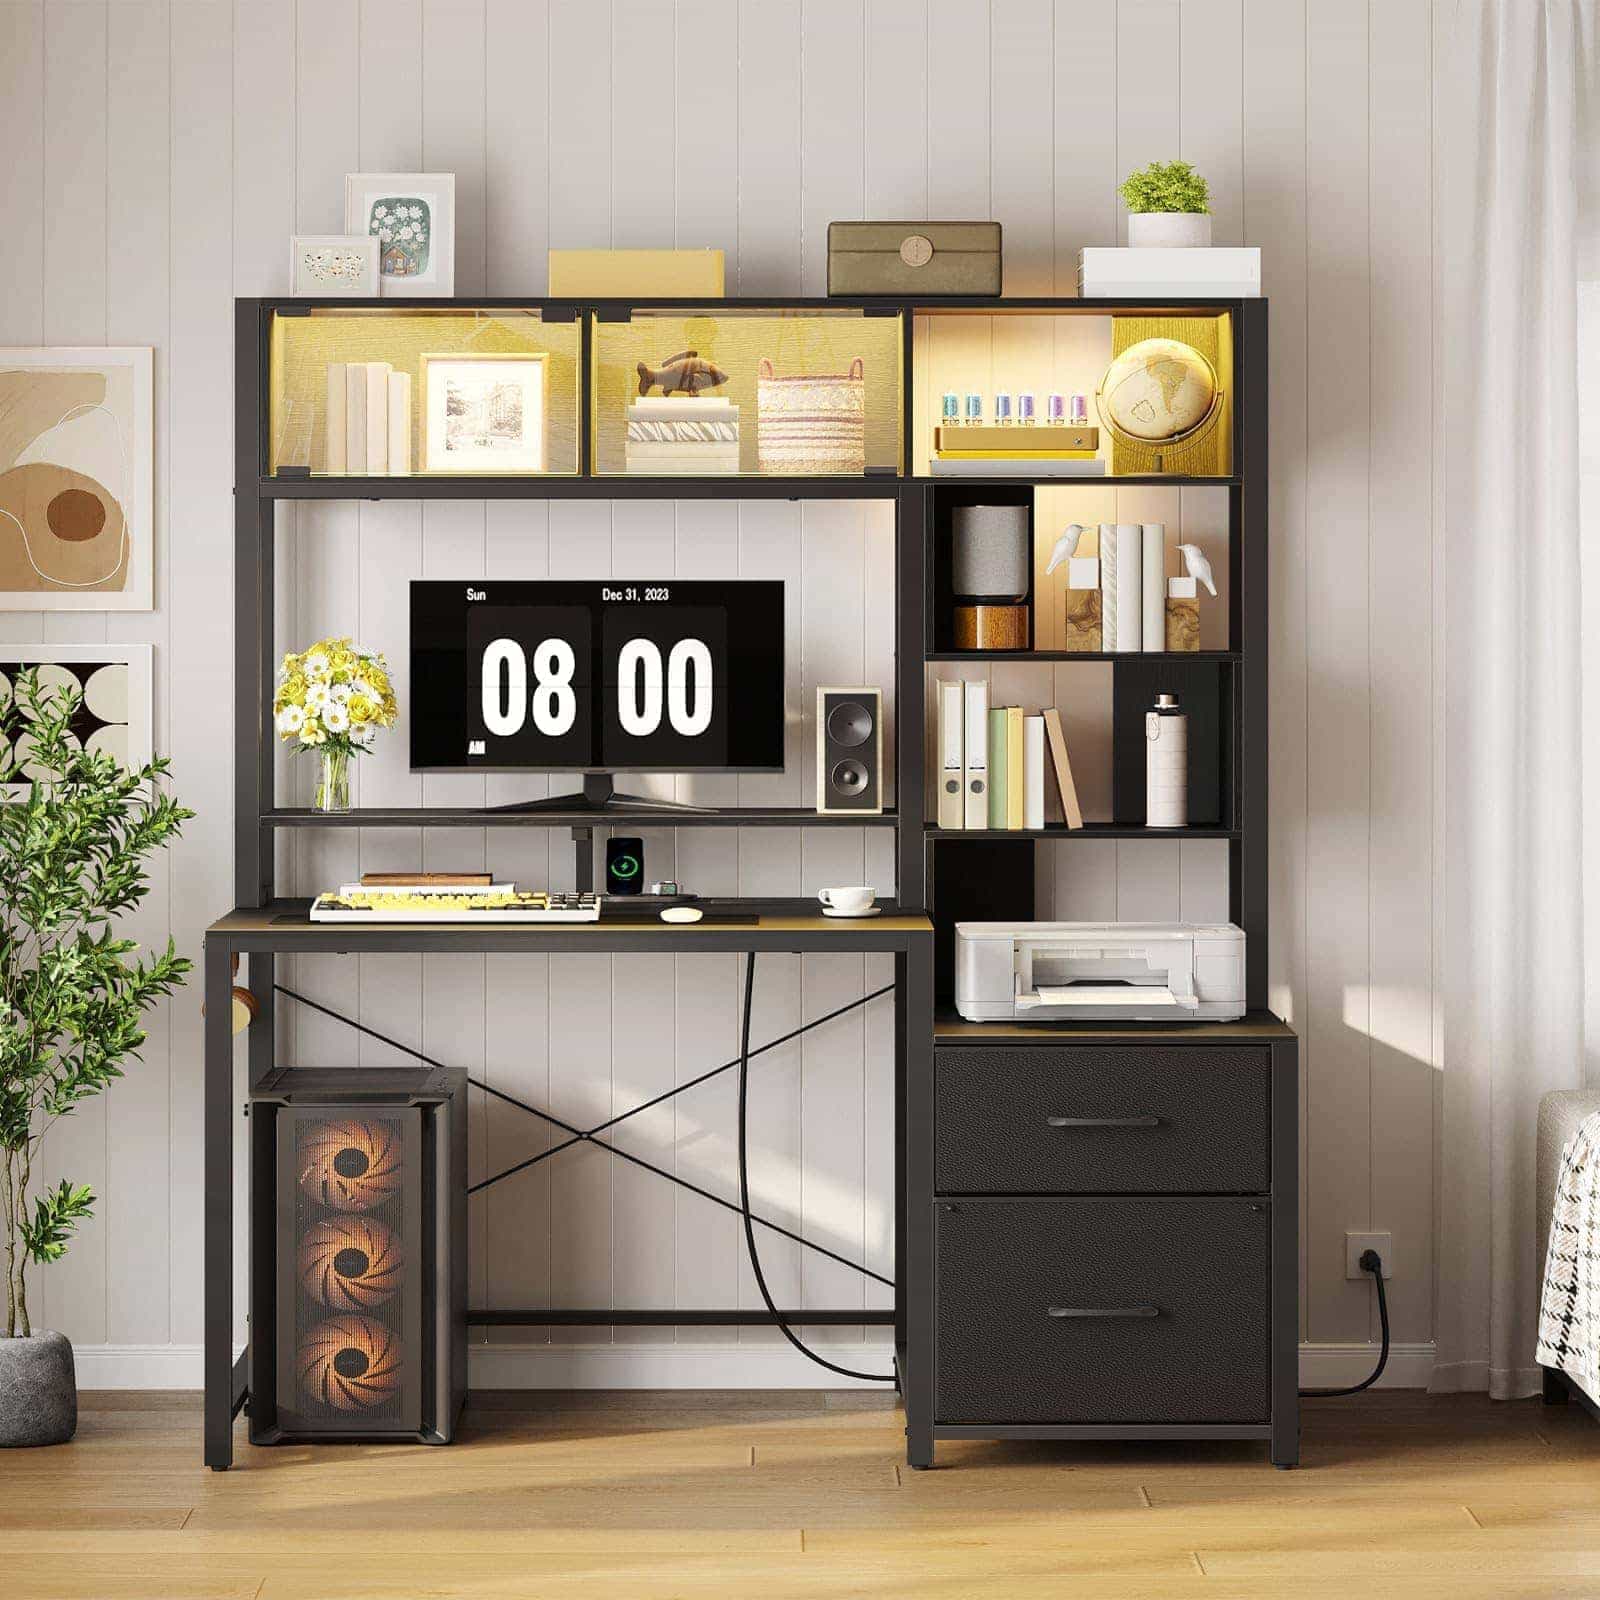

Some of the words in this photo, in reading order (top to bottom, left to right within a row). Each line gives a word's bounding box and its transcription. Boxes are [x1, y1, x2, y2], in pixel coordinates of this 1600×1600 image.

[466, 587, 487, 601] Sun
[602, 587, 623, 601] Dec
[625, 587, 641, 602] 31,
[644, 587, 670, 601] 2023
[481, 638, 577, 737] 08
[617, 638, 713, 737] 00
[467, 740, 486, 755] AM
